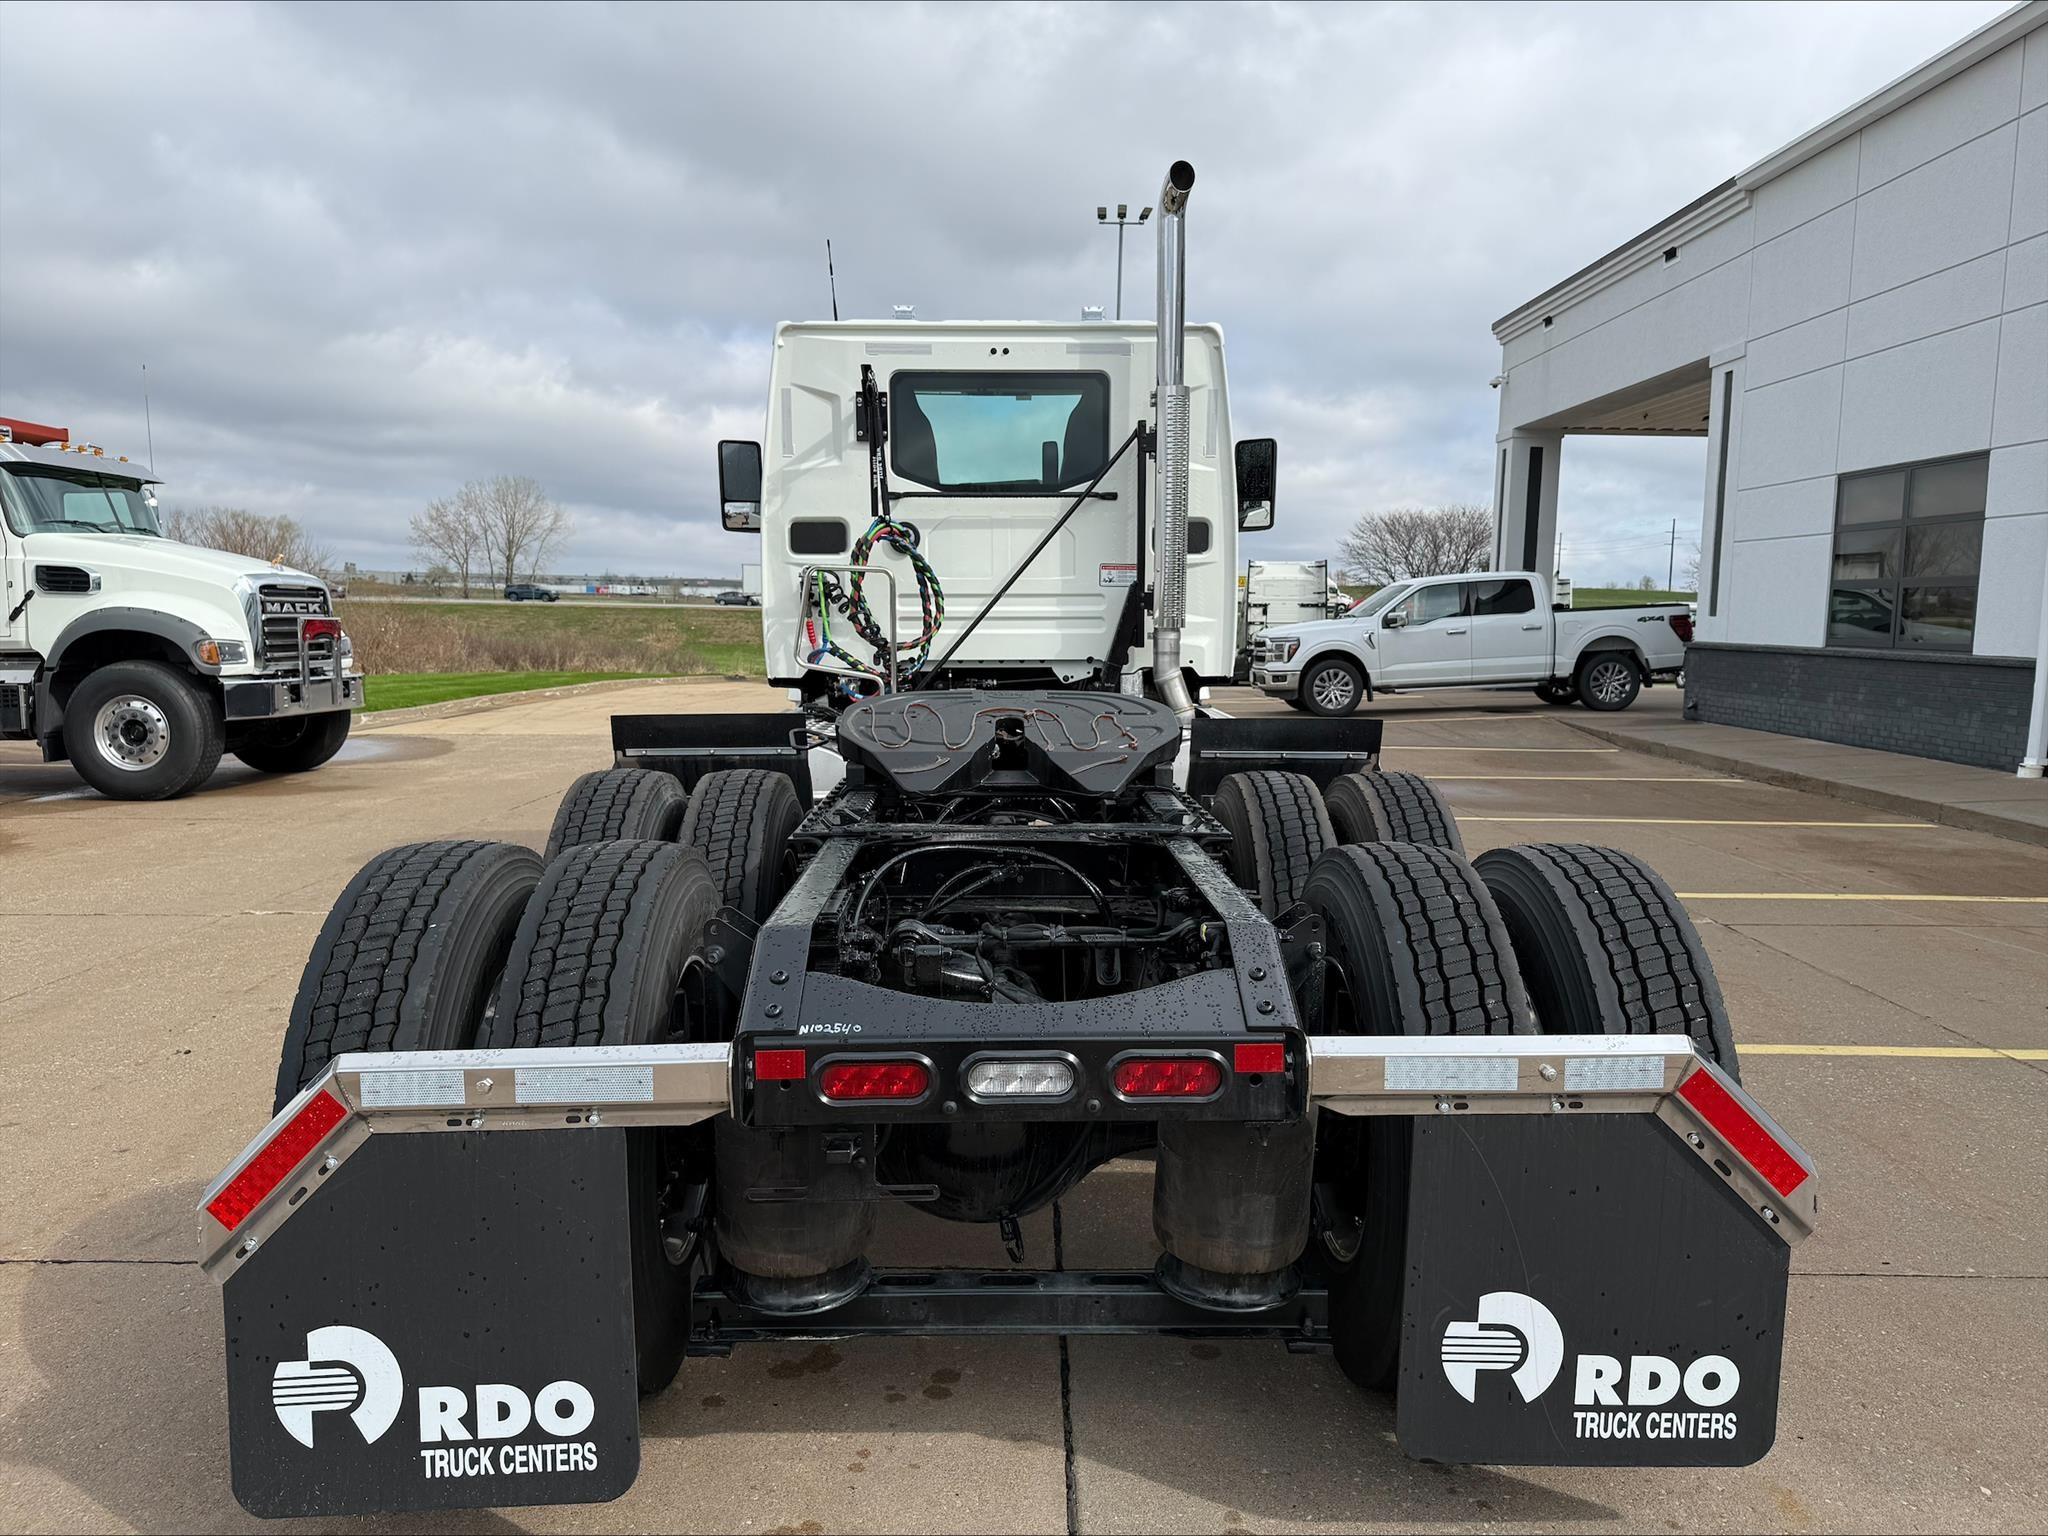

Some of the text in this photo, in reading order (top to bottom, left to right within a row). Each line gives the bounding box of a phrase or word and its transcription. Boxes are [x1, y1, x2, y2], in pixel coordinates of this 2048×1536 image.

[266, 602, 321, 613] MACK
[799, 1022, 862, 1035] N102540
[1574, 1354, 1741, 1407] RDO
[418, 1380, 595, 1442] RDO
[1573, 1411, 1737, 1440] TRUCK CENTERS
[420, 1441, 598, 1479] TRUCK CENTERS
